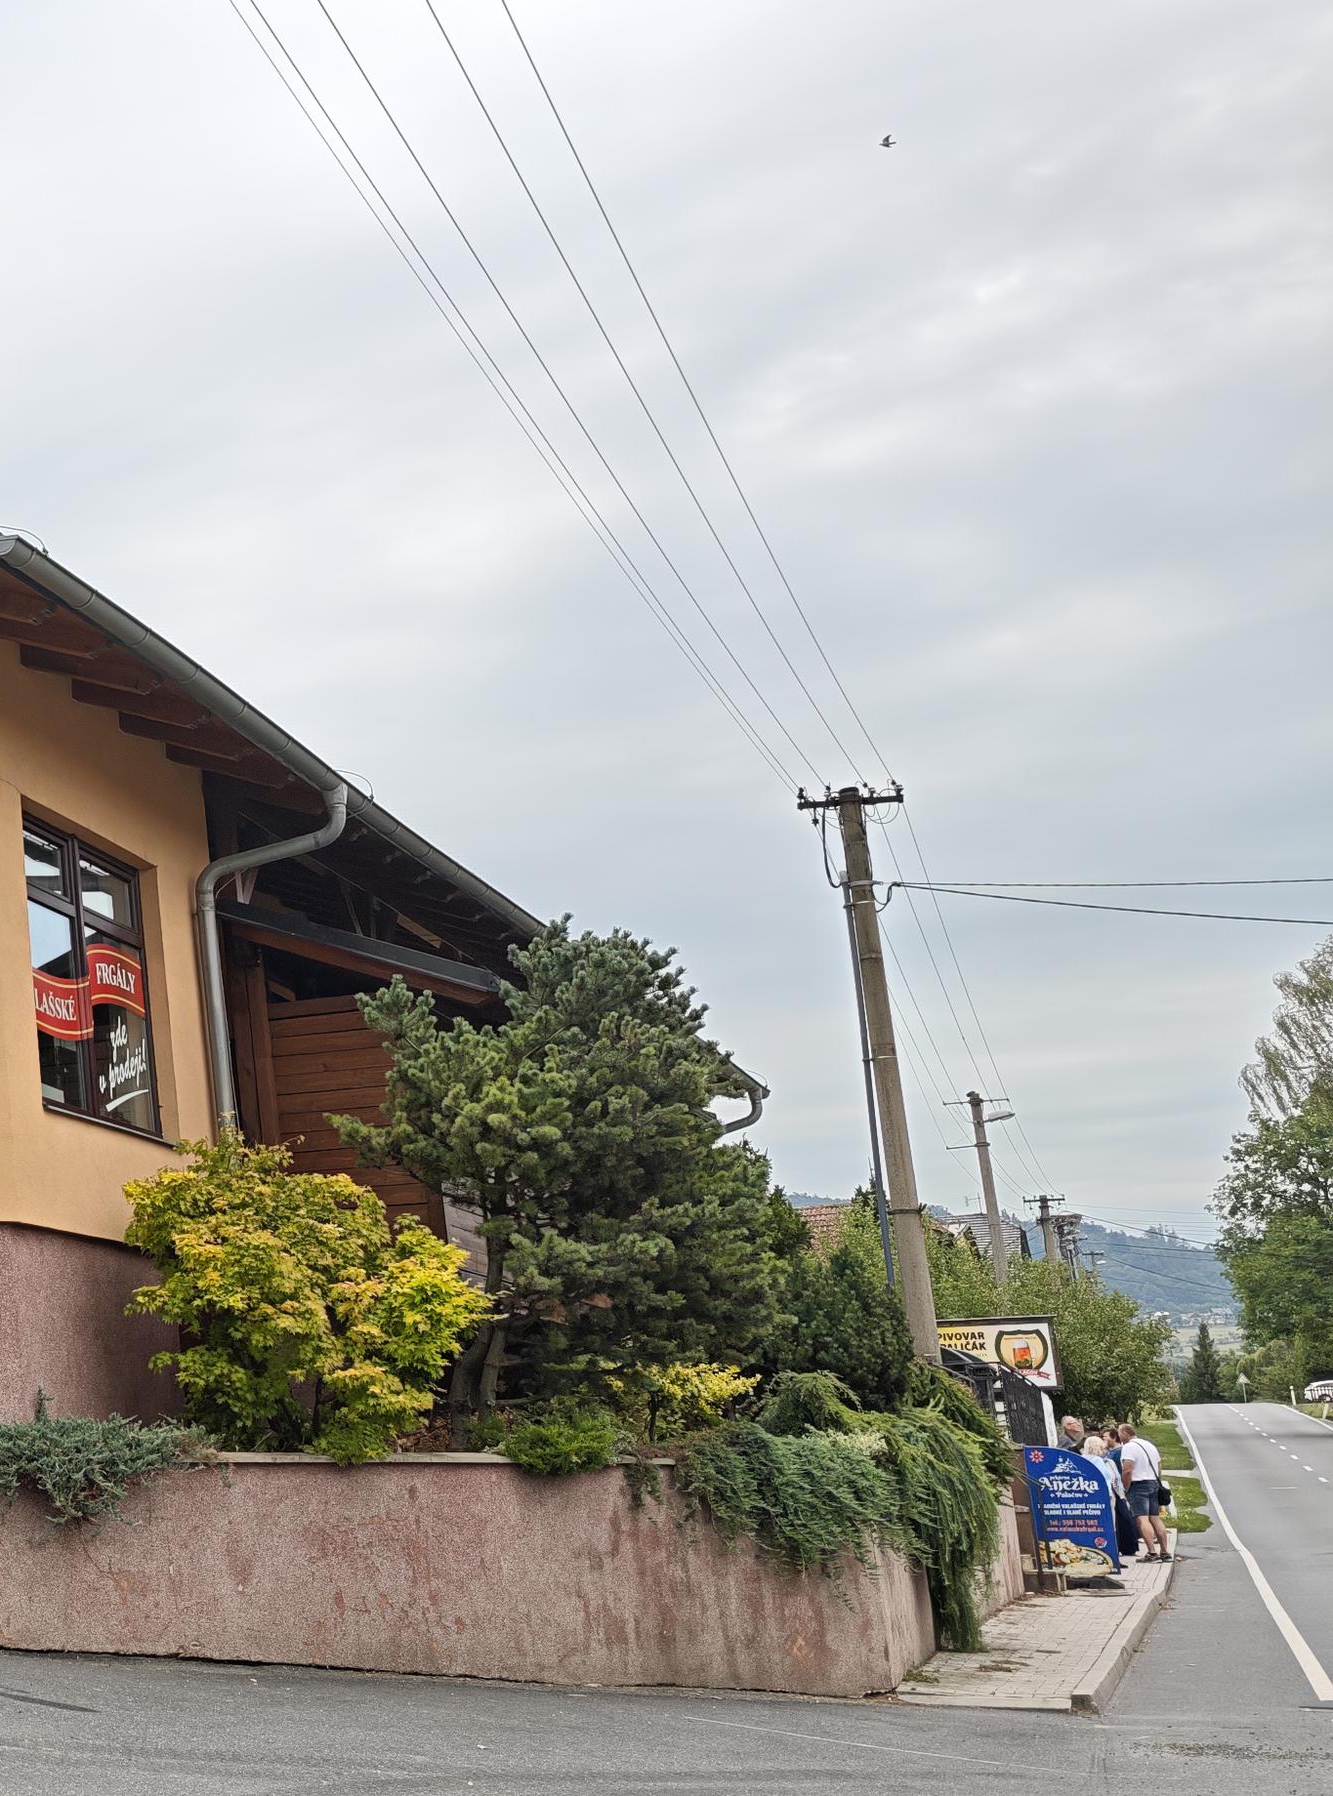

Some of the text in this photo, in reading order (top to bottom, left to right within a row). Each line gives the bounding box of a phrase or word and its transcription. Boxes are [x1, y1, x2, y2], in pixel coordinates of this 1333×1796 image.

[95, 962, 135, 995] FRGÁLY
[34, 987, 76, 1021] LAŠSKÉ
[110, 1015, 128, 1063] zde
[99, 1038, 147, 1099] v prodeji!
[937, 1331, 985, 1341] PIVOVAR
[1038, 1476, 1100, 1494] Anežka
